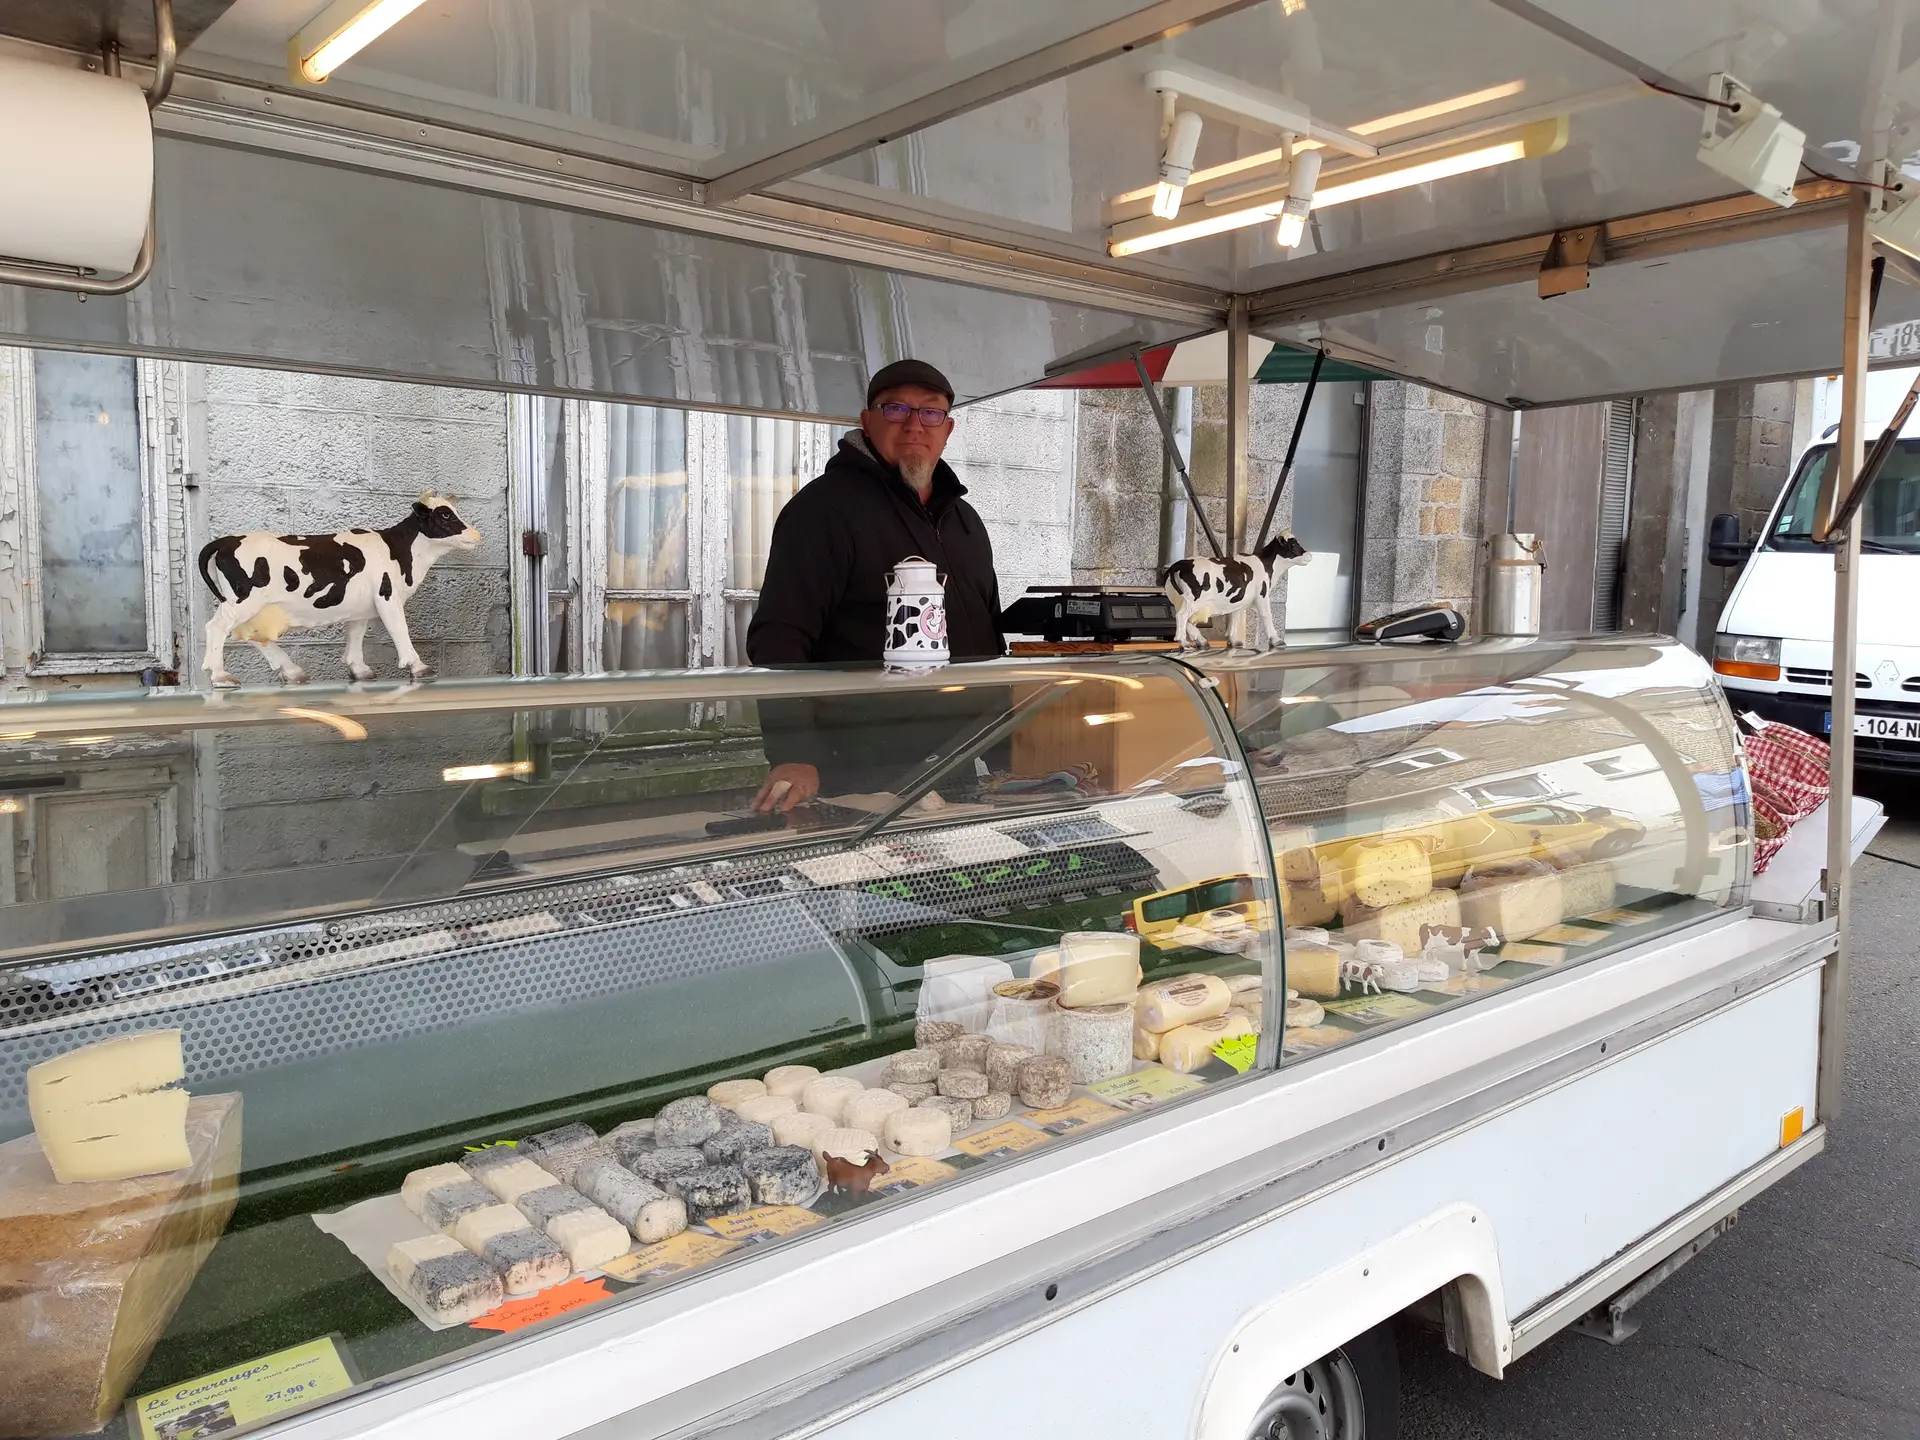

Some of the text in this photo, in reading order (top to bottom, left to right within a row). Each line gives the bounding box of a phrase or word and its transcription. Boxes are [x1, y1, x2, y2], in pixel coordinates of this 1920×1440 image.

[145, 1363, 271, 1412] Le Carrouges
[263, 1371, 282, 1380] mois
[147, 1385, 239, 1421] TOMME DE VACHE
[265, 1380, 317, 1403] 27,90 €
